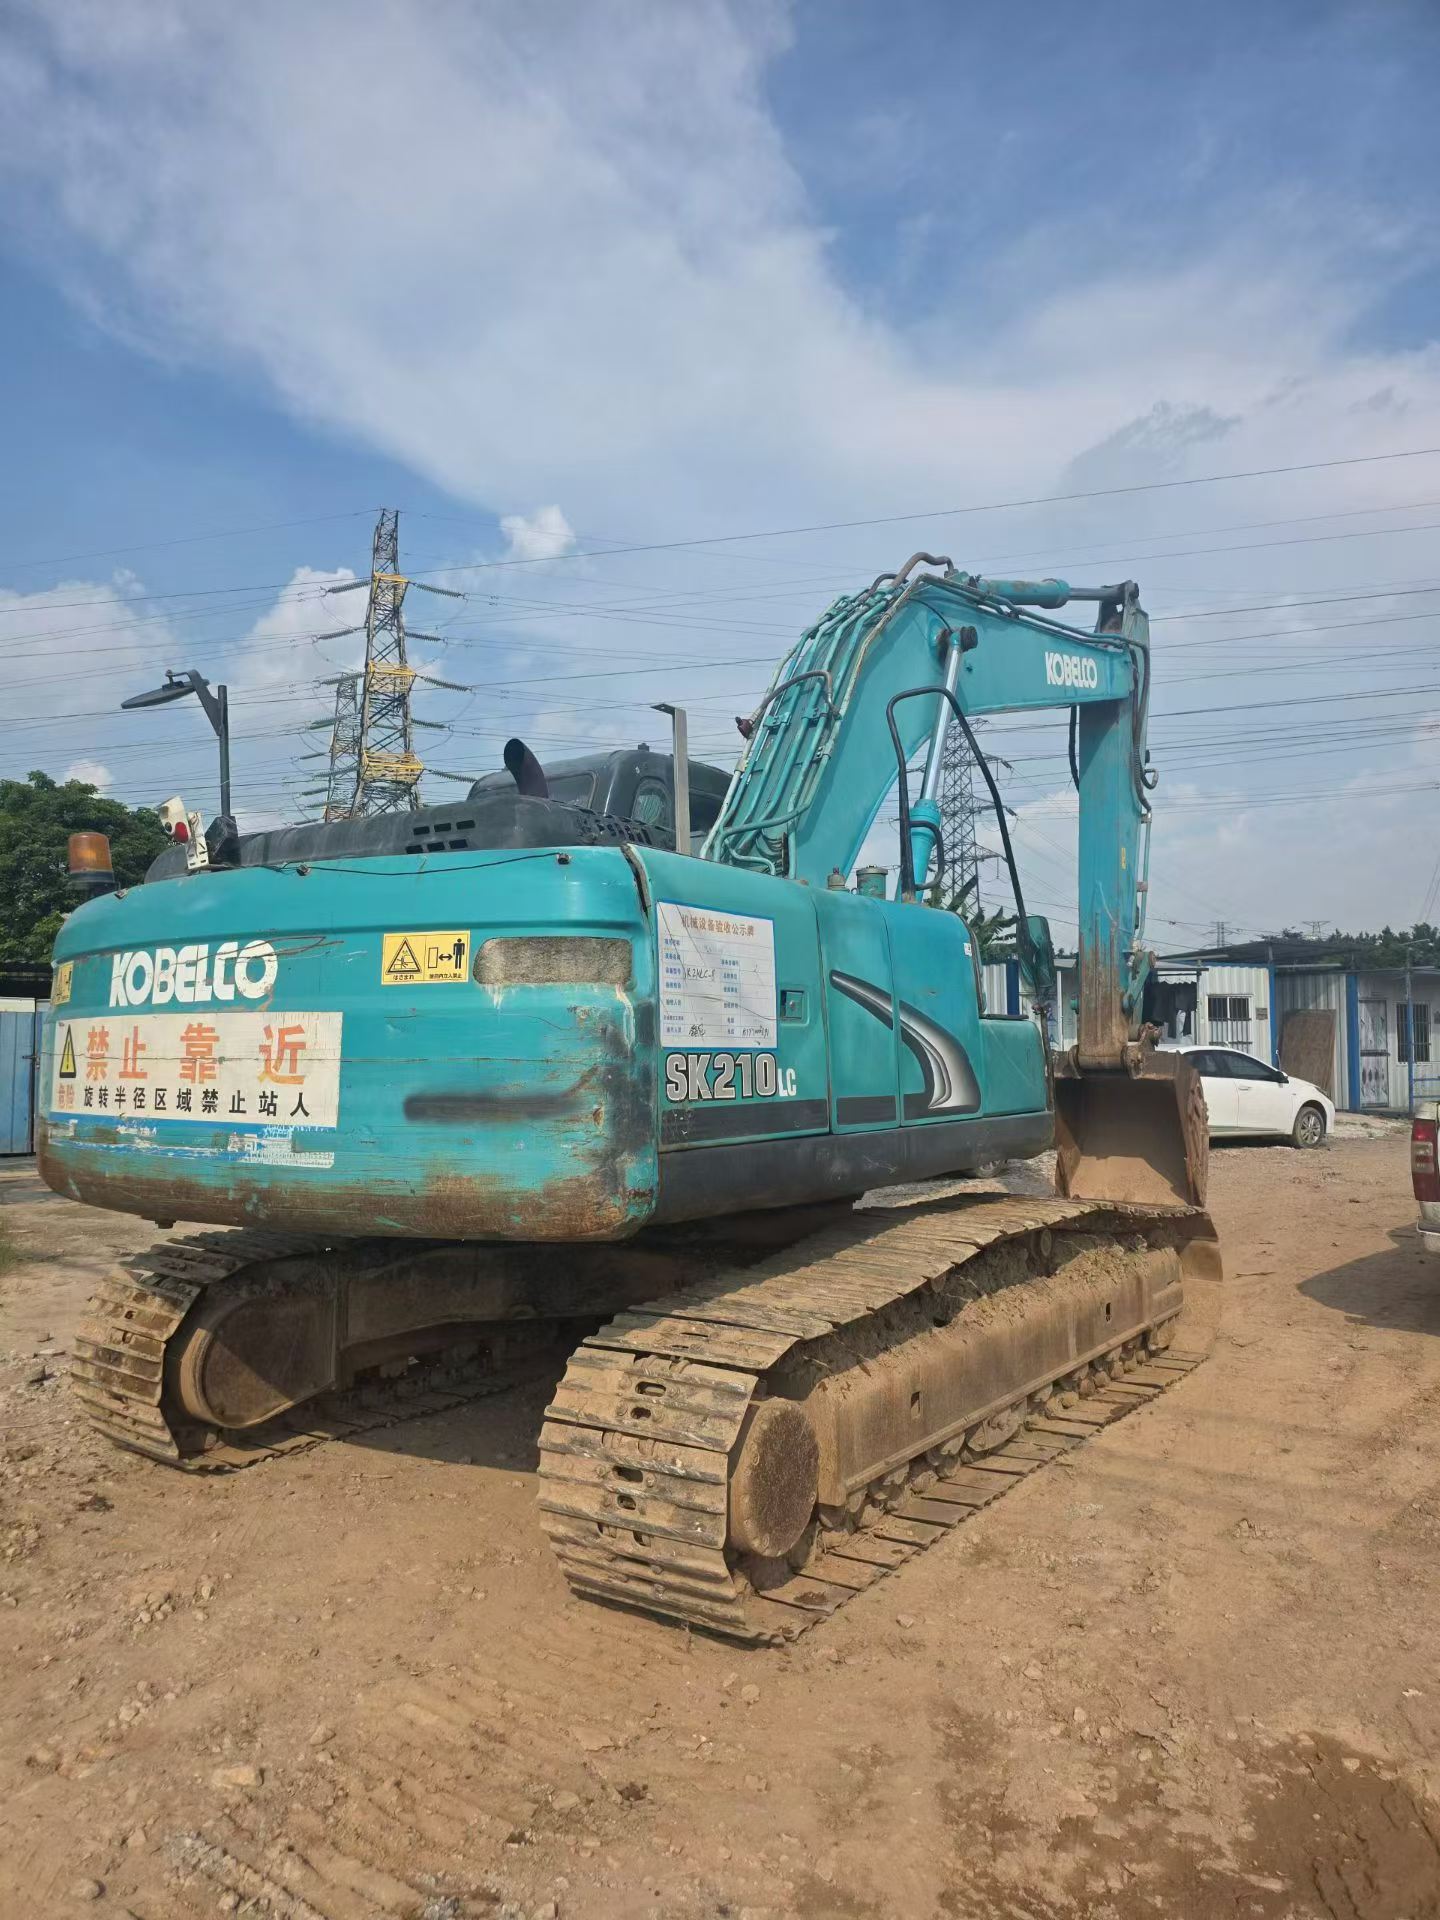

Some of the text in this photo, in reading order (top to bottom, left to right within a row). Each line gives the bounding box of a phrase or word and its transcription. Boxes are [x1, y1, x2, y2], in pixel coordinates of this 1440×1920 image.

[1044, 651, 1097, 688] KOBELCO
[109, 940, 278, 1008] KOBELCO
[86, 1023, 307, 1085] 禁止靠近
[57, 1084, 75, 1111] 危险
[665, 1052, 797, 1102] SK210 LC
[83, 1085, 311, 1118] 旋转半径区域禁止站人
